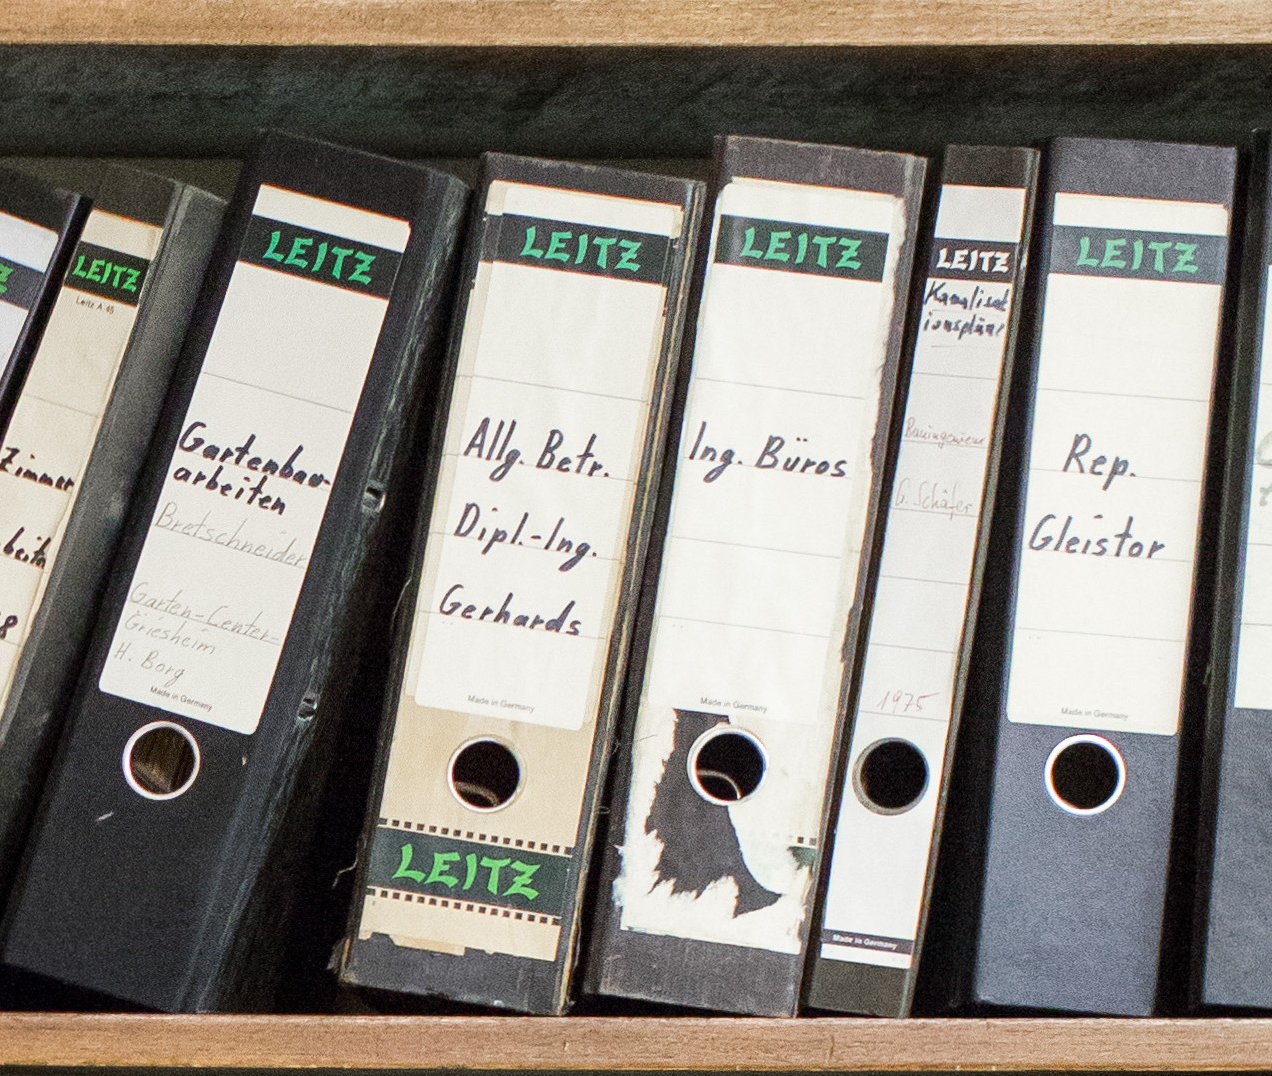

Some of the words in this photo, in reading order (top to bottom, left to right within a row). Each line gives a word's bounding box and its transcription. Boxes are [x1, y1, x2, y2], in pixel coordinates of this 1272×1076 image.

[262, 231, 376, 285] LEITZ
[521, 226, 642, 272] LEITZ
[739, 227, 861, 269] LEITZ
[936, 247, 1010, 273] LEITZ
[1076, 236, 1198, 273] LEITZ
[72, 254, 141, 293] LEITZ
[464, 417, 524, 482] Allg.
[537, 428, 610, 478] Betr.
[688, 420, 743, 484] Ing.
[755, 435, 848, 478] Büros
[1063, 433, 1137, 491] Rep.
[173, 464, 286, 516] arbeiten
[153, 500, 307, 568] Bretschneider
[1028, 513, 1166, 559] Gleistor
[439, 583, 581, 636] Gerhards
[140, 650, 185, 687] Borg
[150, 686, 169, 698] Made
[179, 694, 213, 712] Germany
[467, 695, 488, 706] Made
[491, 699, 499, 708] in
[501, 700, 535, 713] Germany
[700, 696, 721, 707] Made
[724, 699, 731, 708] in
[733, 700, 767, 714] Germany
[876, 691, 941, 712] 1975
[1061, 707, 1081, 717] Made
[1084, 709, 1091, 718] in
[1094, 709, 1128, 721] Germany
[392, 844, 541, 900] LEITZ
[832, 934, 853, 944] Made
[864, 937, 897, 950] Germany
